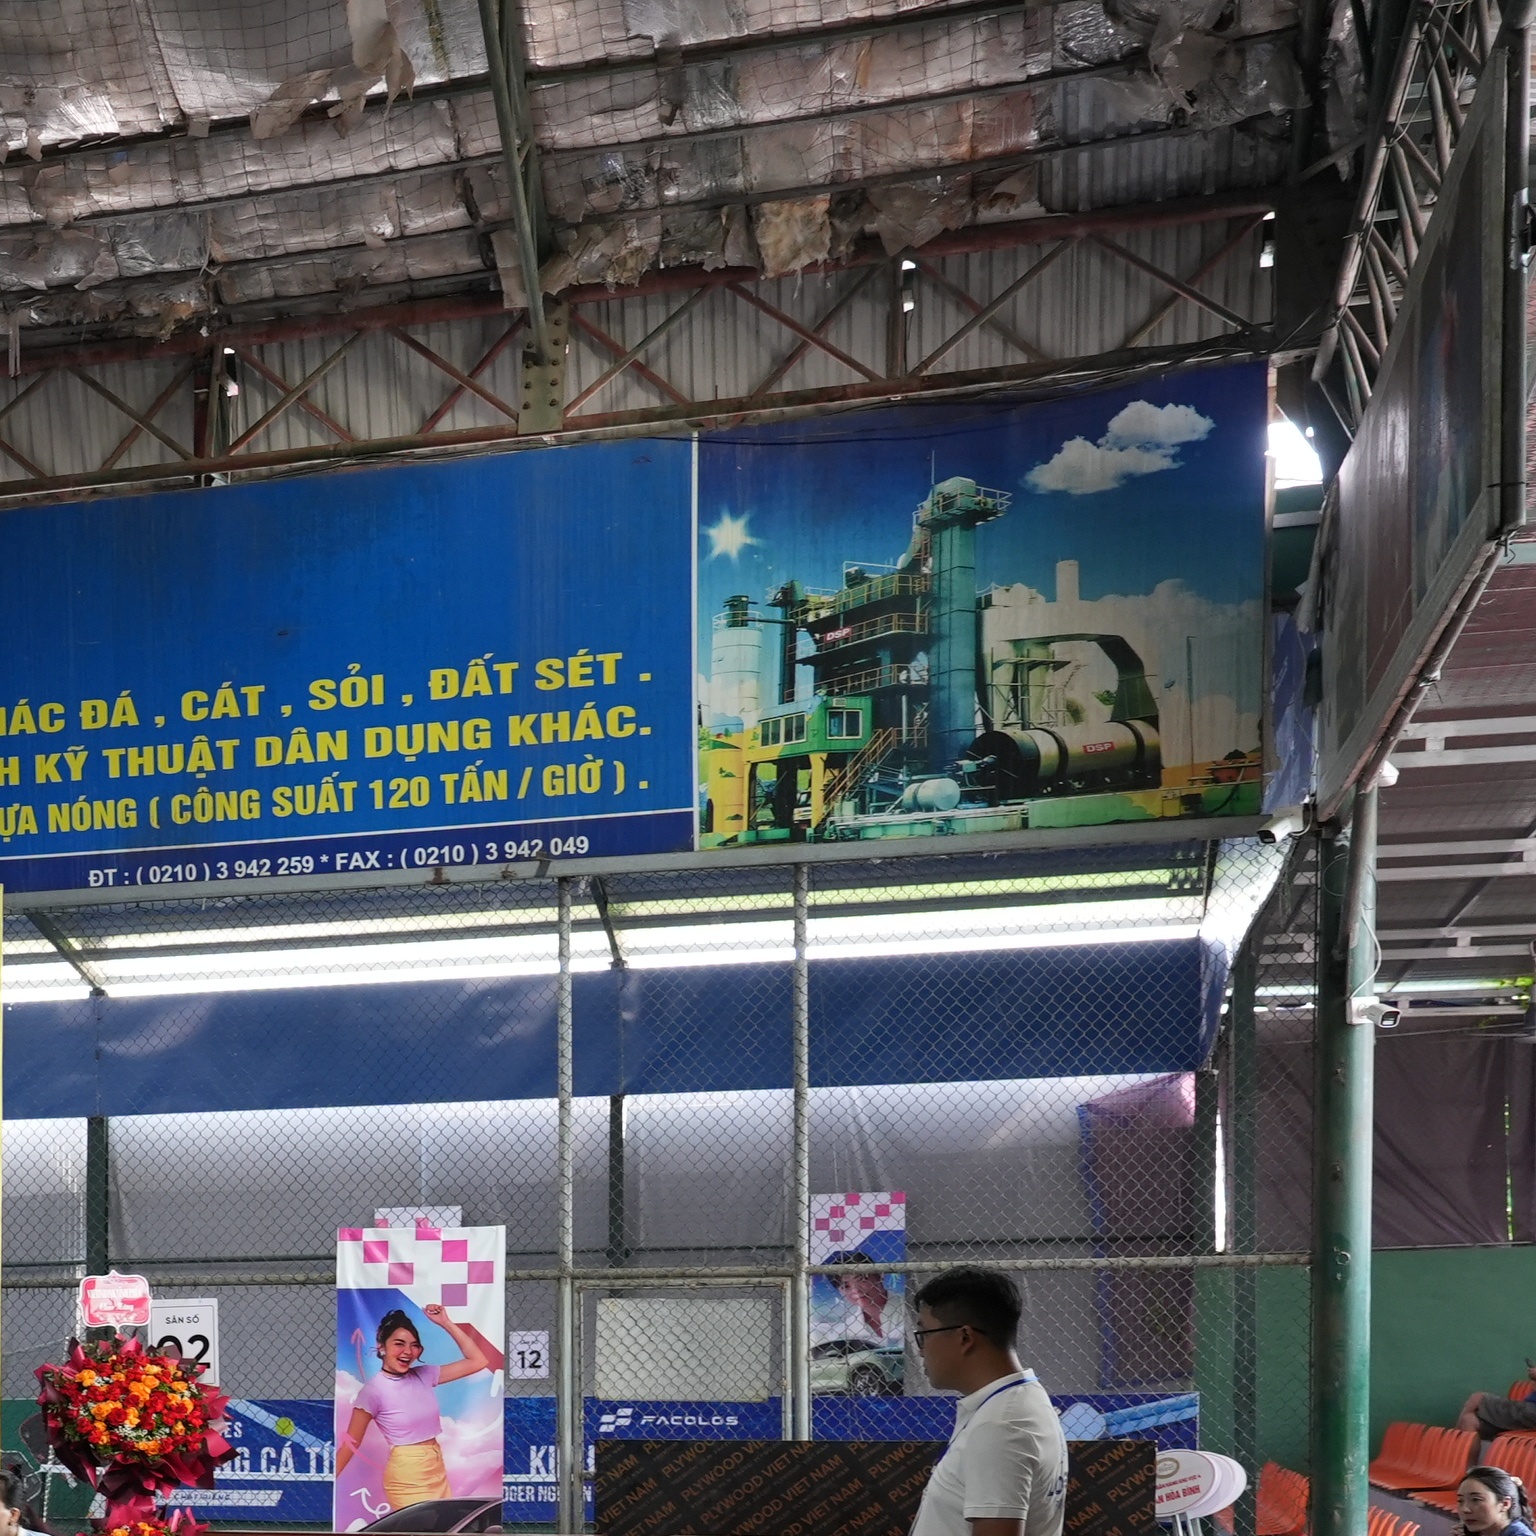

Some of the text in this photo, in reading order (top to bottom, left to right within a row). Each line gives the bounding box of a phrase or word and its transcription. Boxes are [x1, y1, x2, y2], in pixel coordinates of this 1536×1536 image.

[826, 627, 851, 641] DSP
[79, 690, 139, 730] ĐÁ
[181, 681, 265, 721] CÁT
[308, 663, 384, 710] SỎI
[428, 653, 519, 700] ĐẤT
[535, 649, 623, 690] SÉT
[1086, 742, 1113, 754] DSP
[517, 1351, 542, 1368] 12
[640, 1416, 738, 1425] FACOLOS
